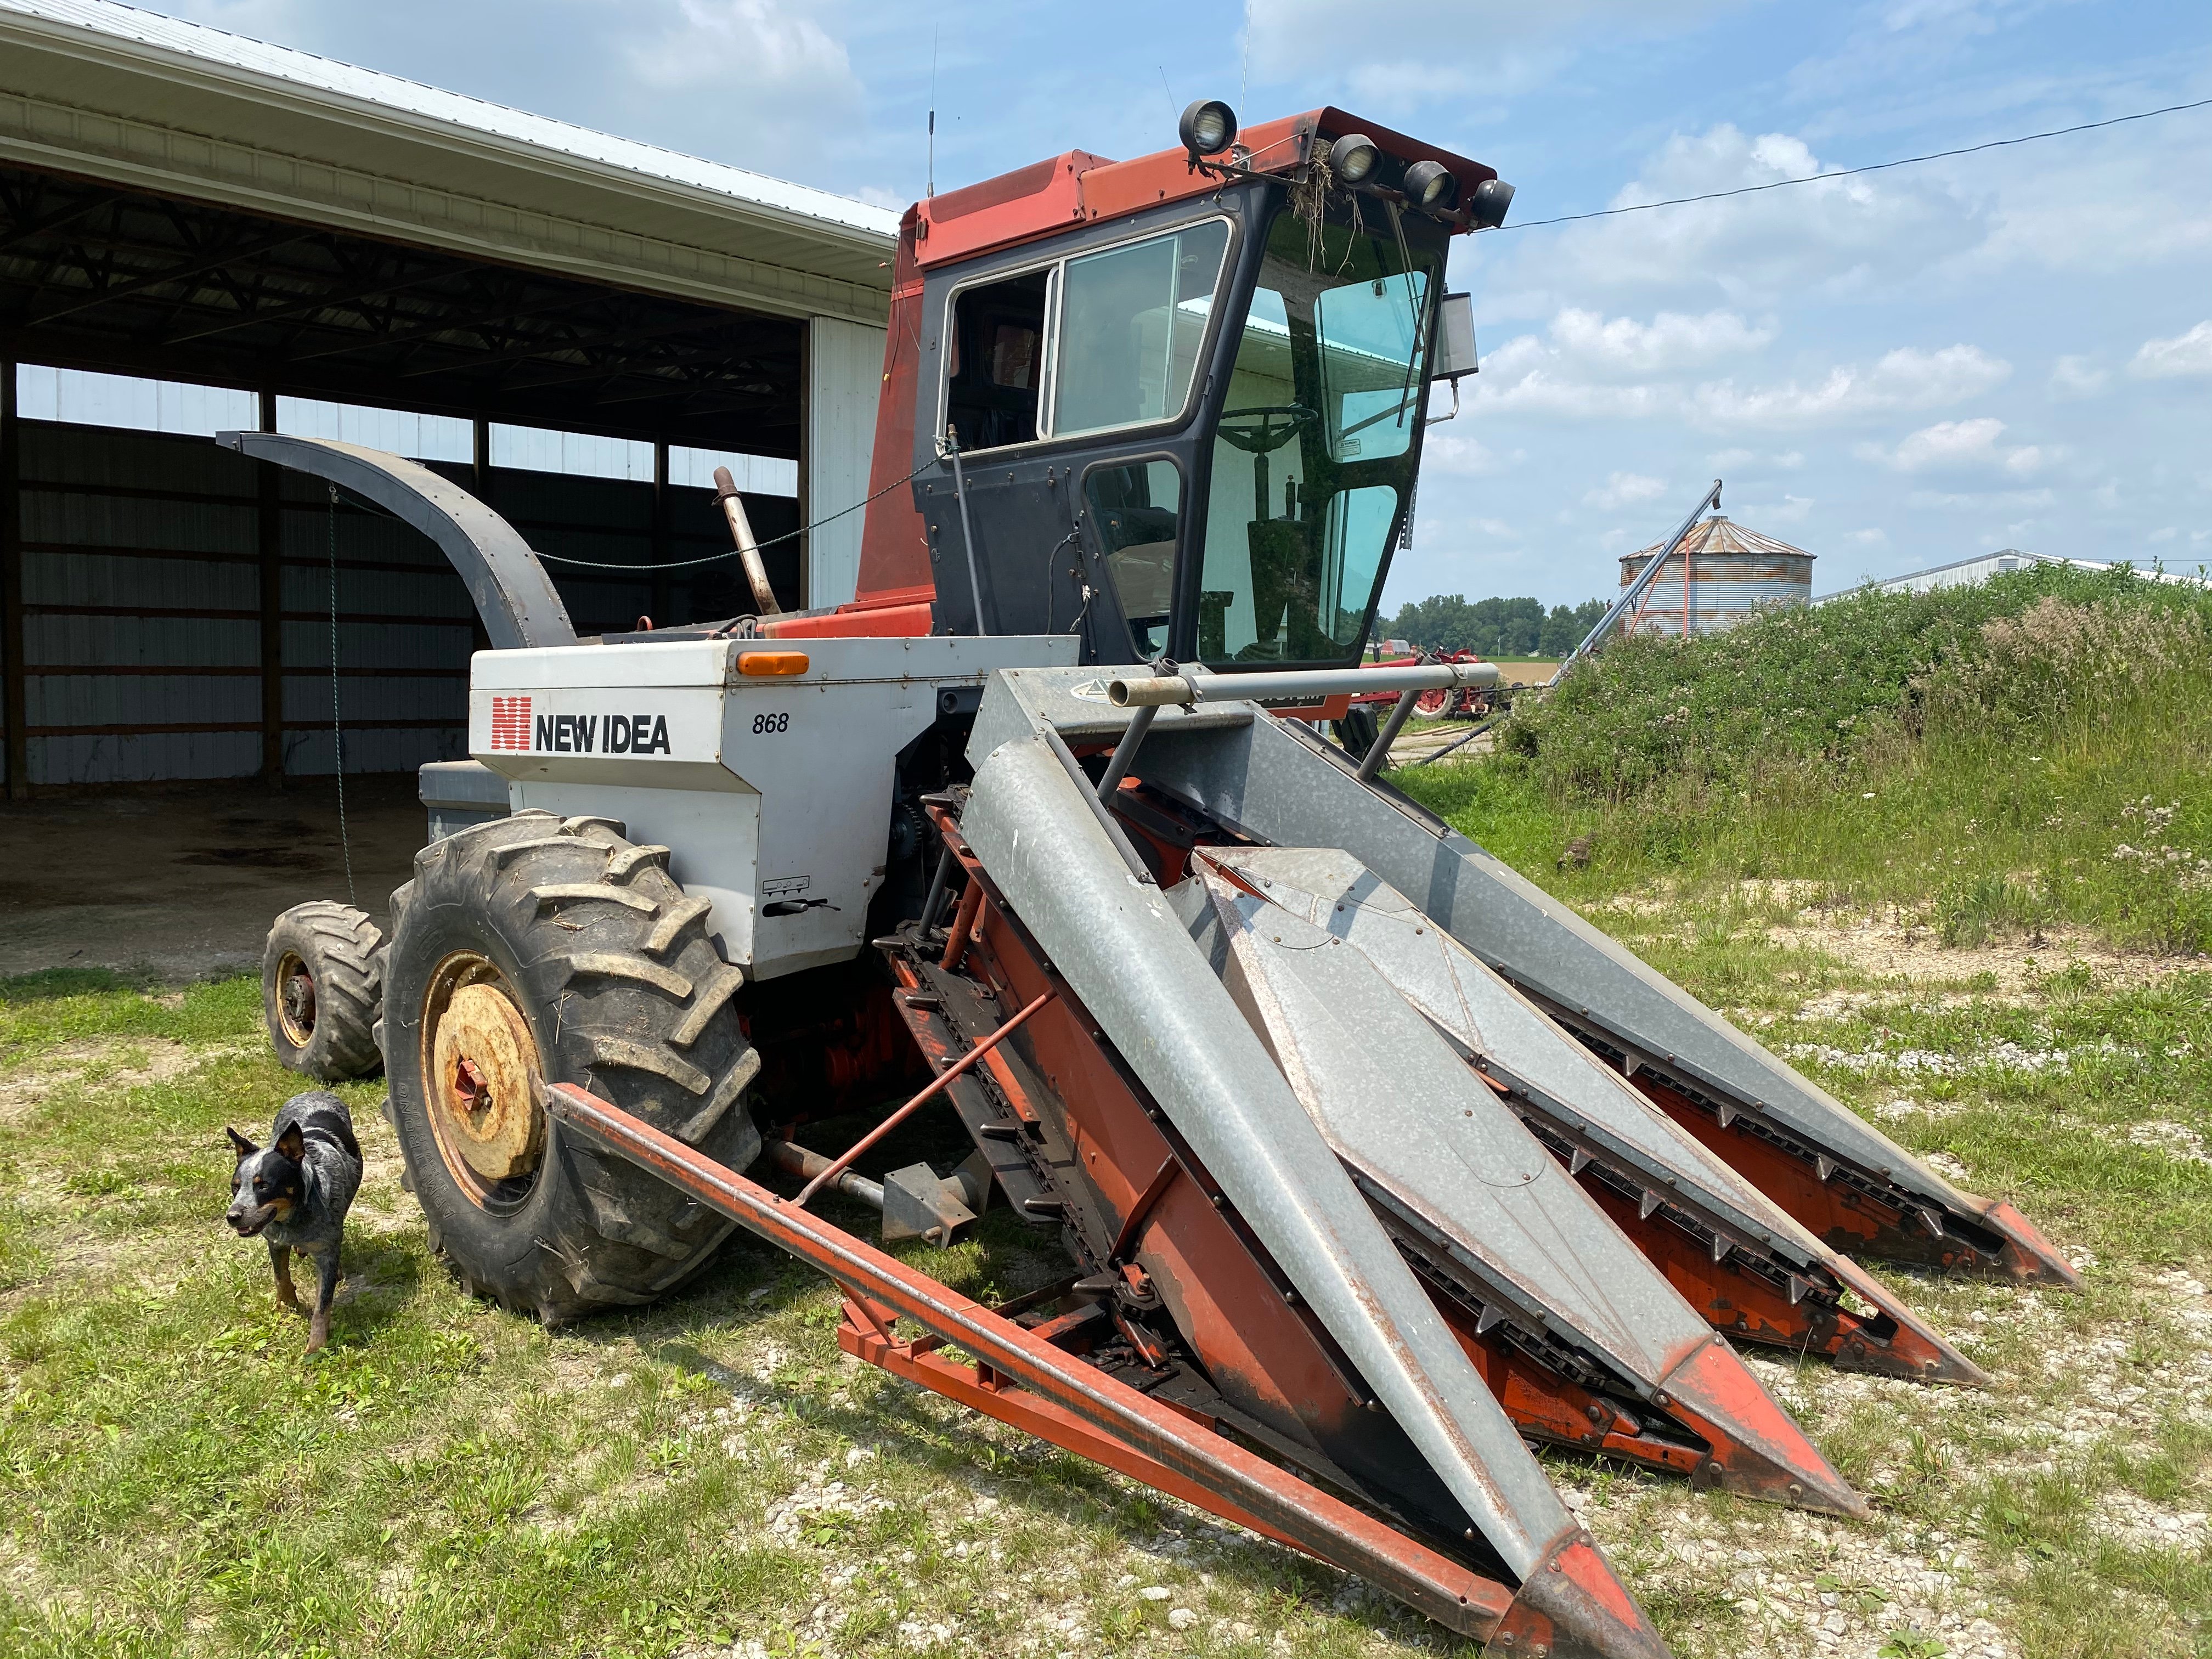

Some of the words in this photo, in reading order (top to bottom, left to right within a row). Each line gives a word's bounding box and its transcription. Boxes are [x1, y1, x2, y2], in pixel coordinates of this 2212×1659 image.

[536, 714, 597, 752] NEW
[602, 715, 671, 755] IDEA
[752, 713, 789, 735] 868
[397, 1082, 456, 1220] ARMSTRONG
